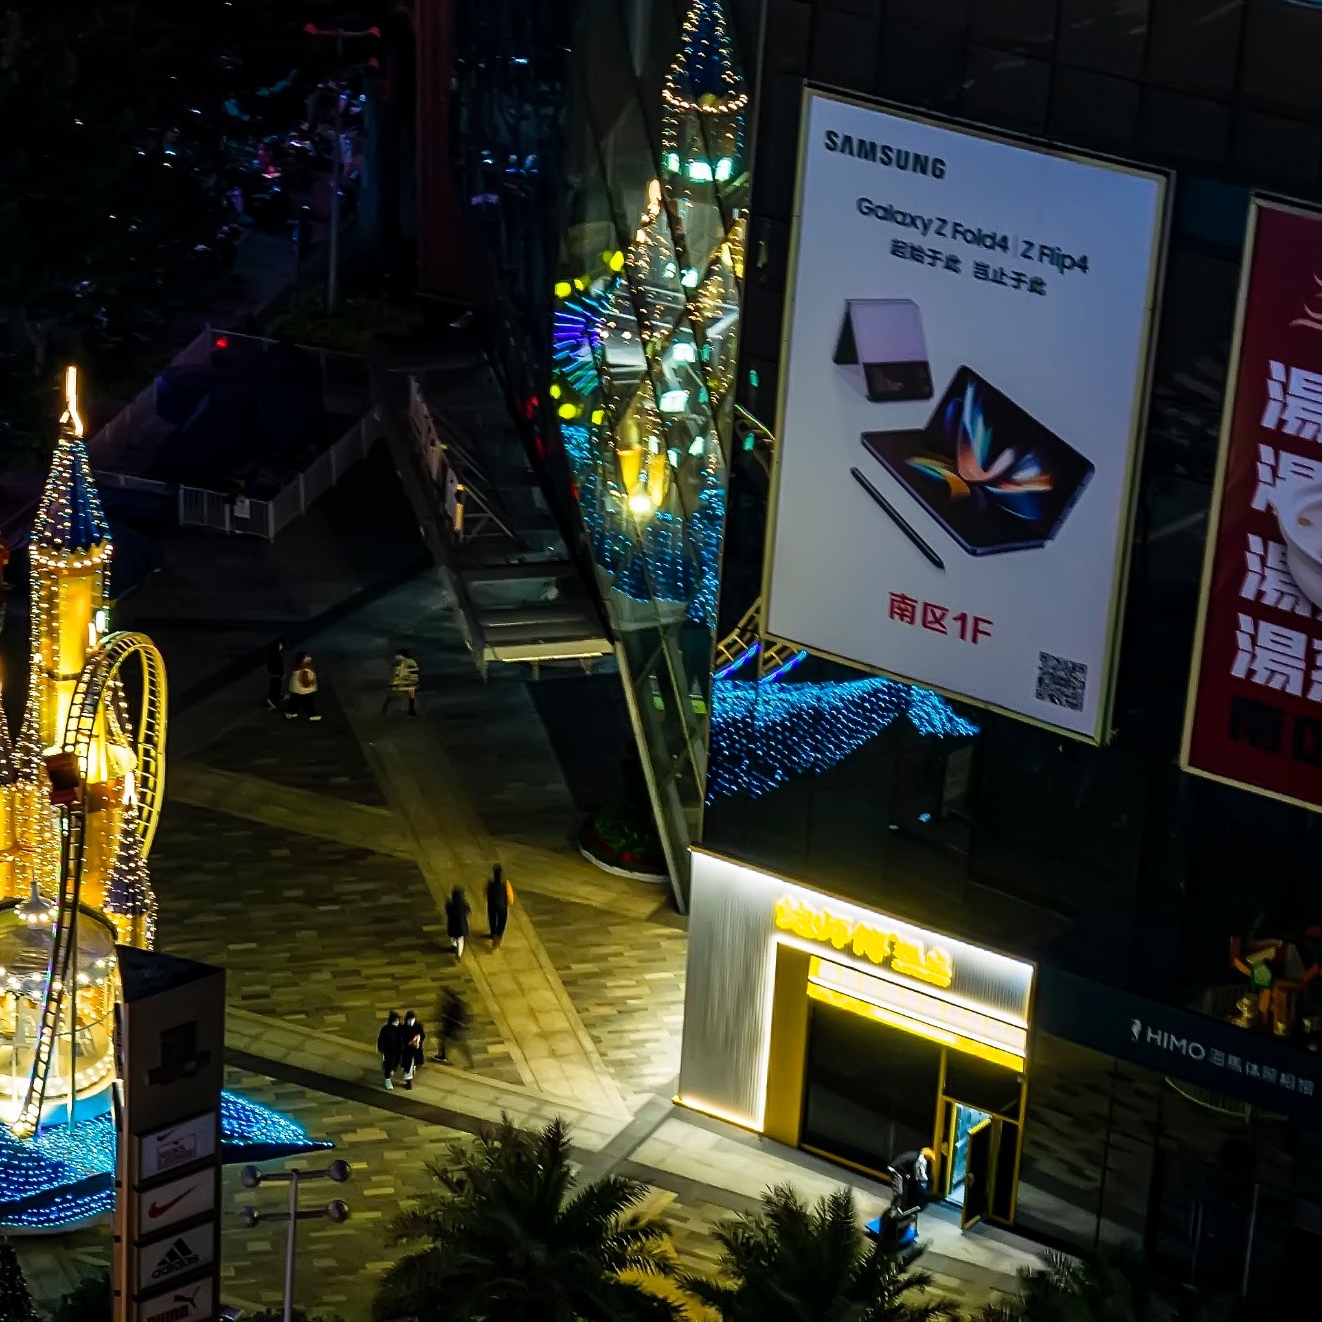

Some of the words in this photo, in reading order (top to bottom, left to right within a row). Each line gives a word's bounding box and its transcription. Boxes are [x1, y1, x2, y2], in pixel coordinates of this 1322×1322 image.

[824, 129, 947, 180] SAMSUNG
[857, 197, 933, 237] Galaxy
[935, 217, 949, 238] Z
[952, 221, 1010, 254] Fold4
[1021, 239, 1035, 261] Z
[1037, 244, 1090, 275] Flip4
[890, 238, 963, 274] 起始于此
[973, 259, 1047, 296] 岂止于此
[888, 591, 993, 645] 南区1F
[1146, 1026, 1205, 1061] HIMO
[151, 1254, 199, 1280] adidas
